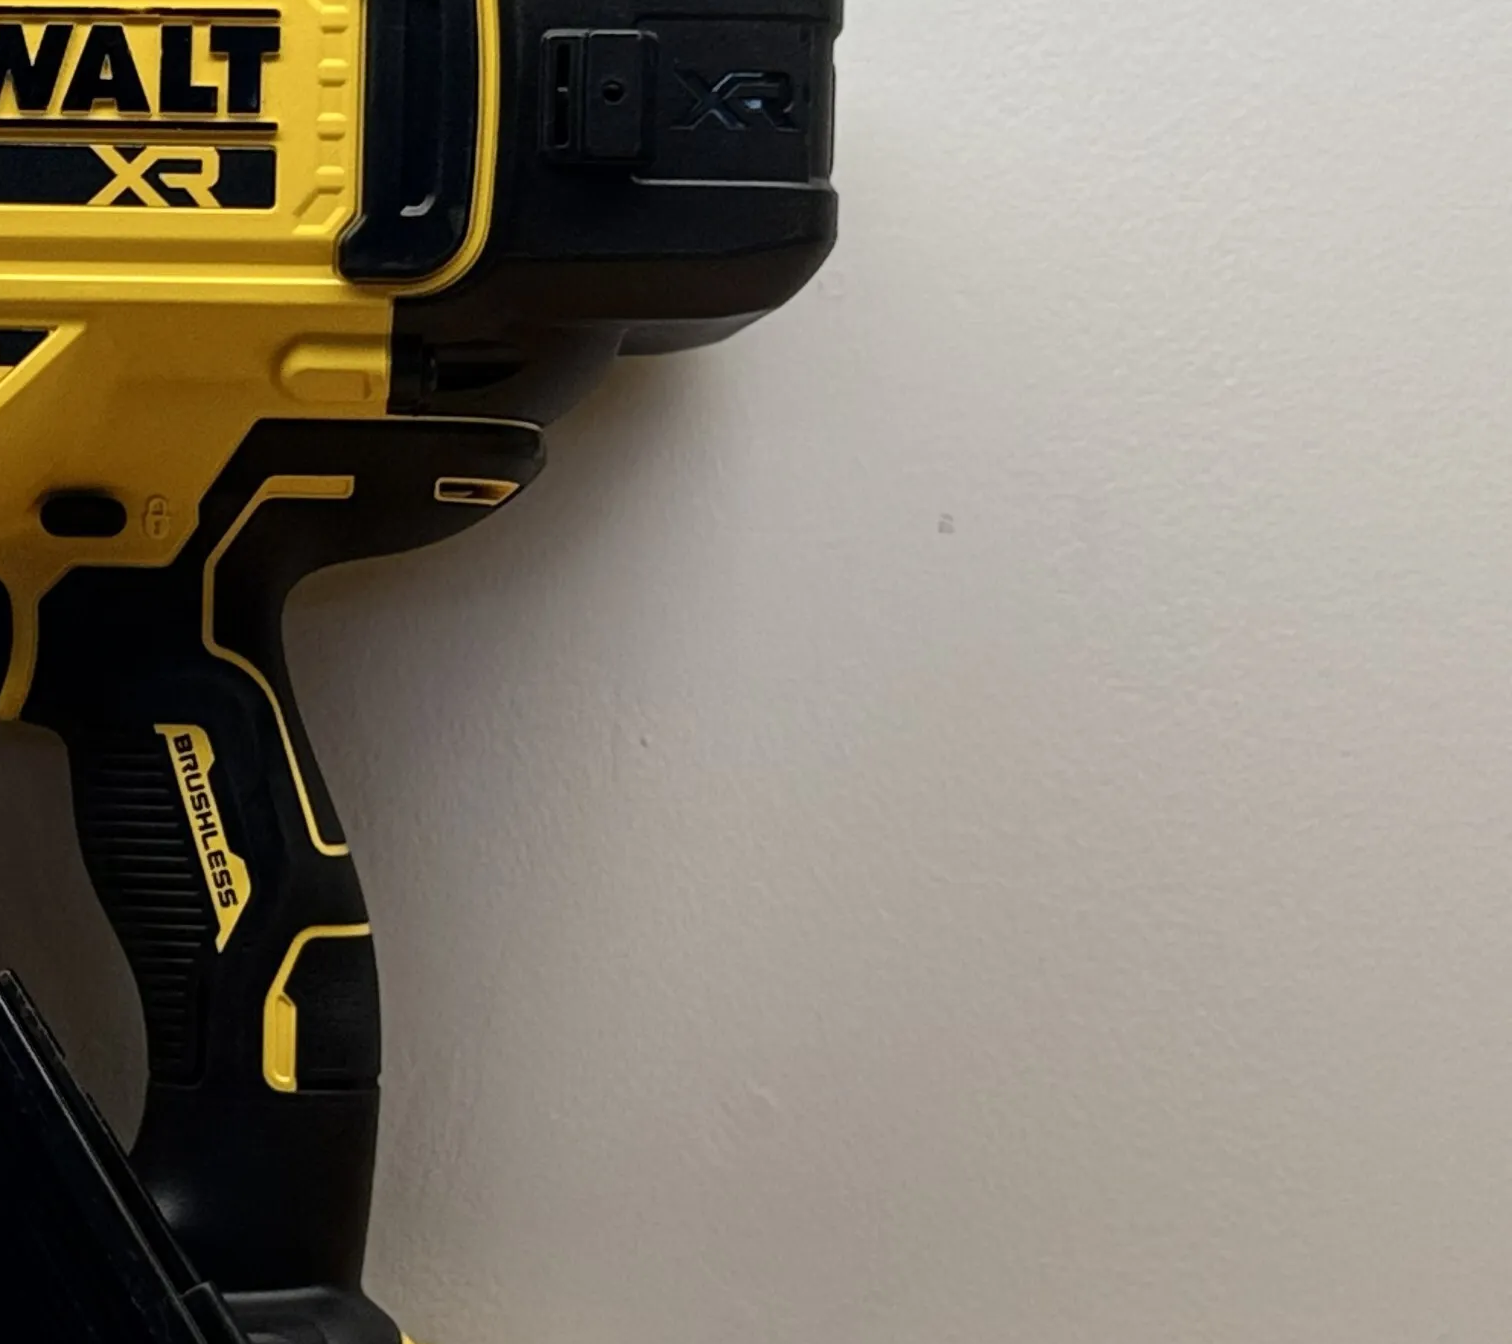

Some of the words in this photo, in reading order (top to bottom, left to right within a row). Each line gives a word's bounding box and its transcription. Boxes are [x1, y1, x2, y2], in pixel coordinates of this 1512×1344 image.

[669, 59, 801, 132] XR
[86, 144, 221, 208] XR
[172, 732, 239, 909] BRUSHLESS
